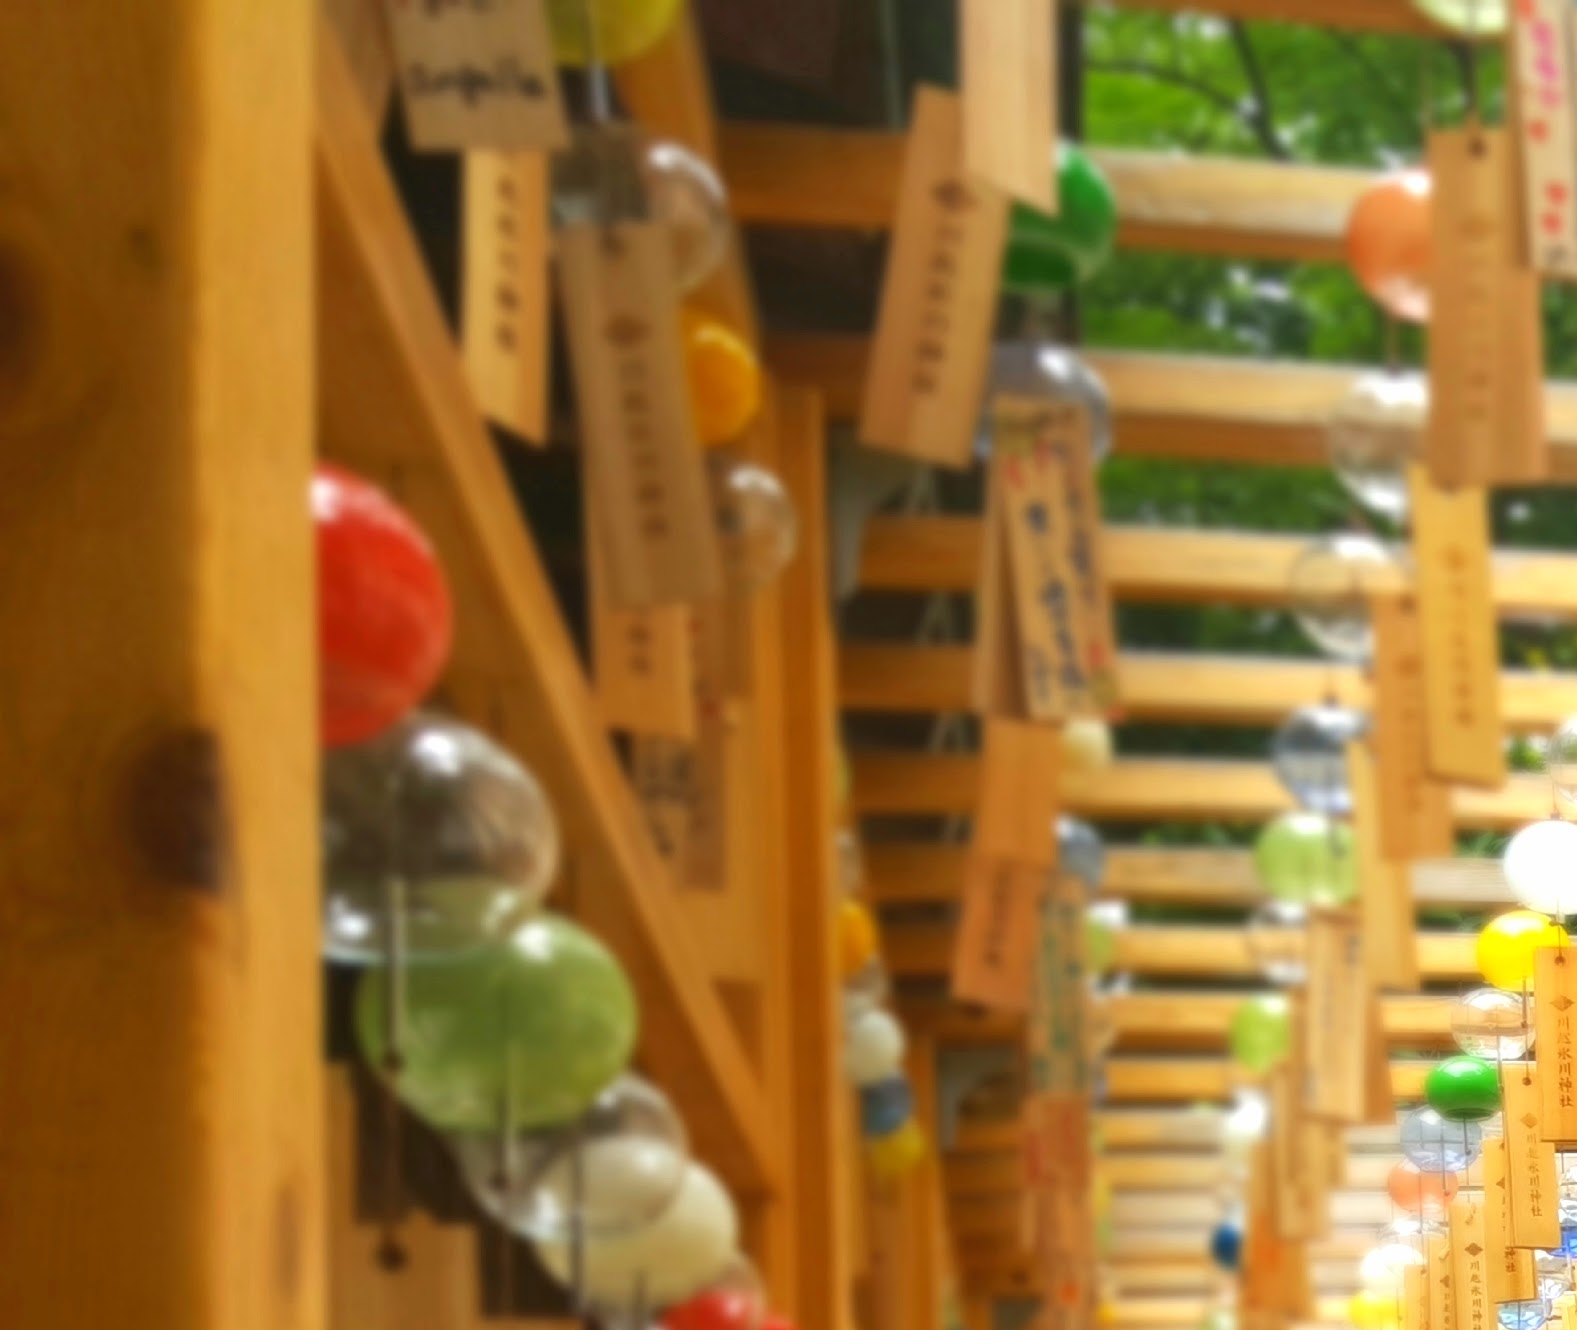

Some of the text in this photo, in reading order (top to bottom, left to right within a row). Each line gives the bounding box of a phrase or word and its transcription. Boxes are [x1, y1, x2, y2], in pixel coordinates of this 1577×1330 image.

[1557, 1016, 1573, 1109] 川越氷川神社
[1526, 1132, 1543, 1218] 川越氷川神社
